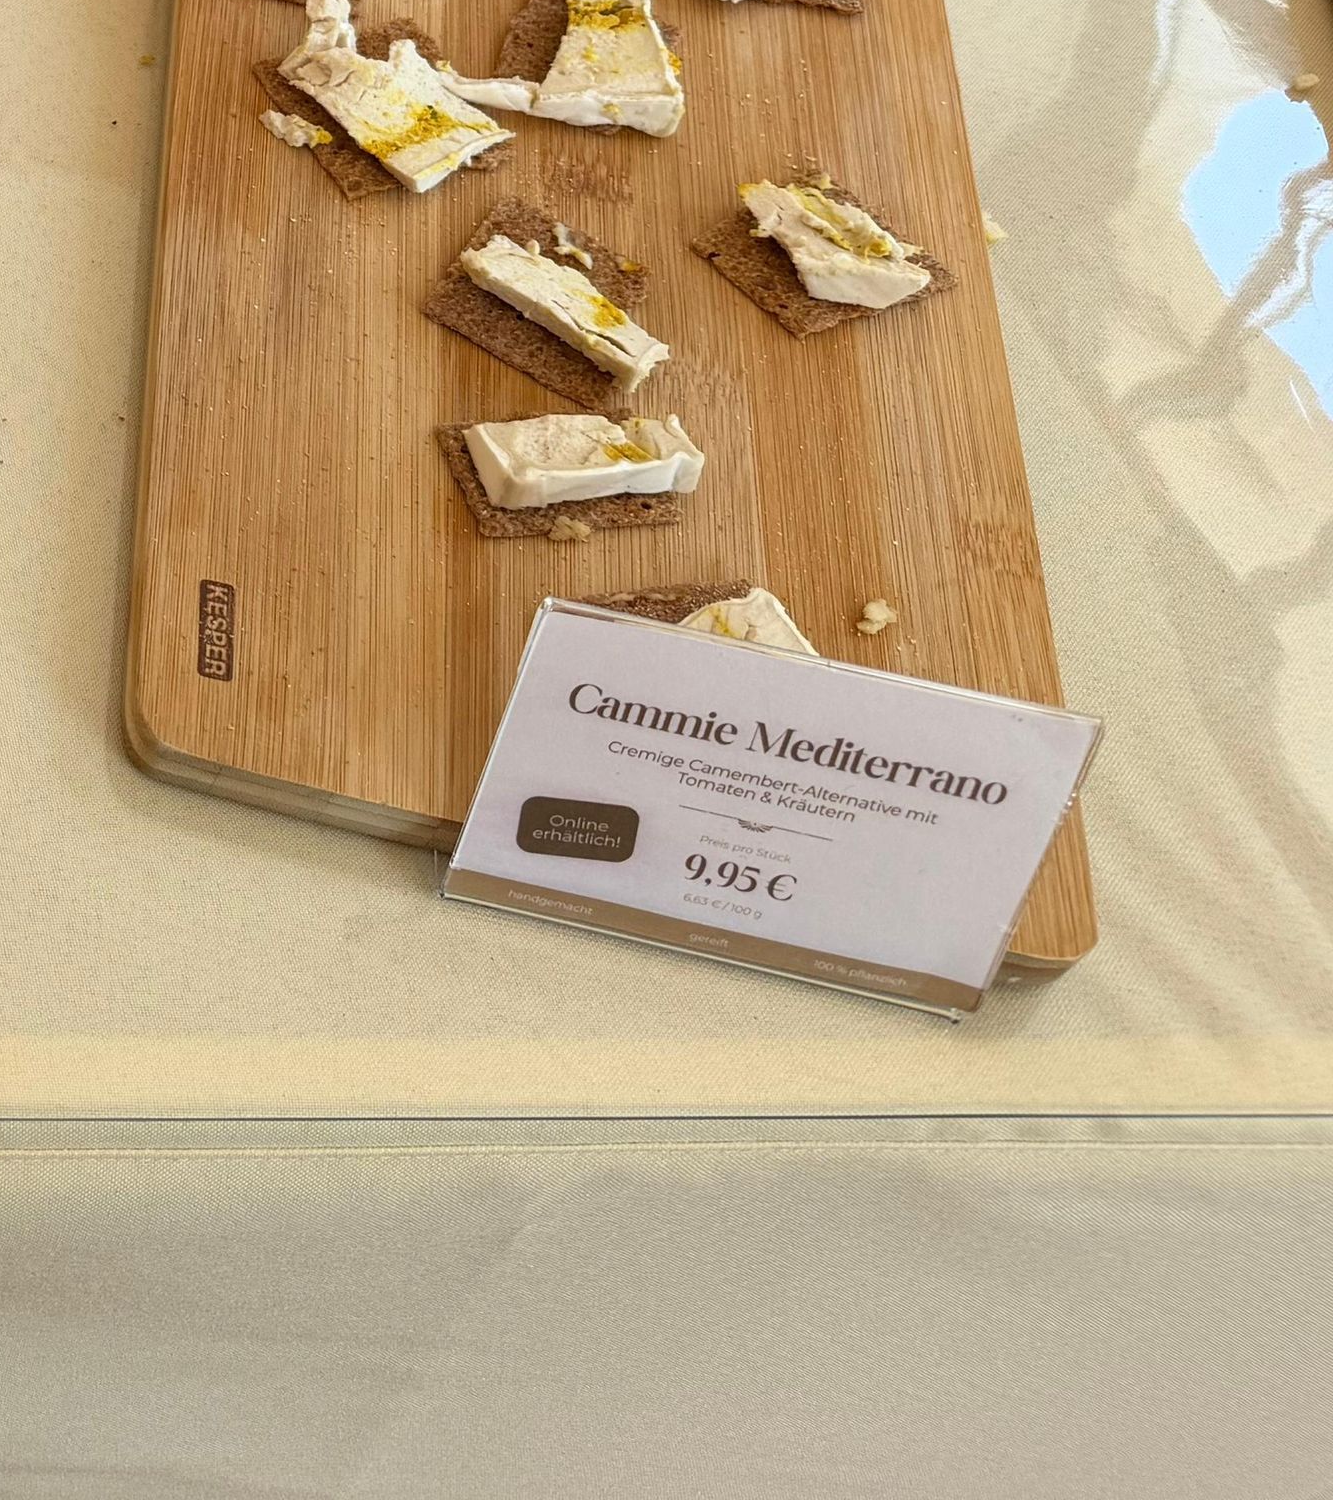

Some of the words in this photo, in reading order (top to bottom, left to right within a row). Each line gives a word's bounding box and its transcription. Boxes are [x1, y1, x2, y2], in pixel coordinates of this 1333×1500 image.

[204, 584, 229, 676] KESPER
[568, 683, 738, 746] Cammie
[745, 721, 1008, 805] Mediterrano
[608, 741, 684, 768] Cremige
[689, 759, 902, 816] Camembert-Alternative
[906, 808, 939, 825] mit
[678, 771, 756, 800] Tomaten
[760, 791, 772, 805] &
[776, 794, 856, 822] Kräutern
[533, 827, 621, 849] erhältlich!
[549, 815, 609, 832] Online
[699, 835, 729, 849] Preis
[732, 843, 753, 855] pro
[508, 889, 594, 916] handgemacht
